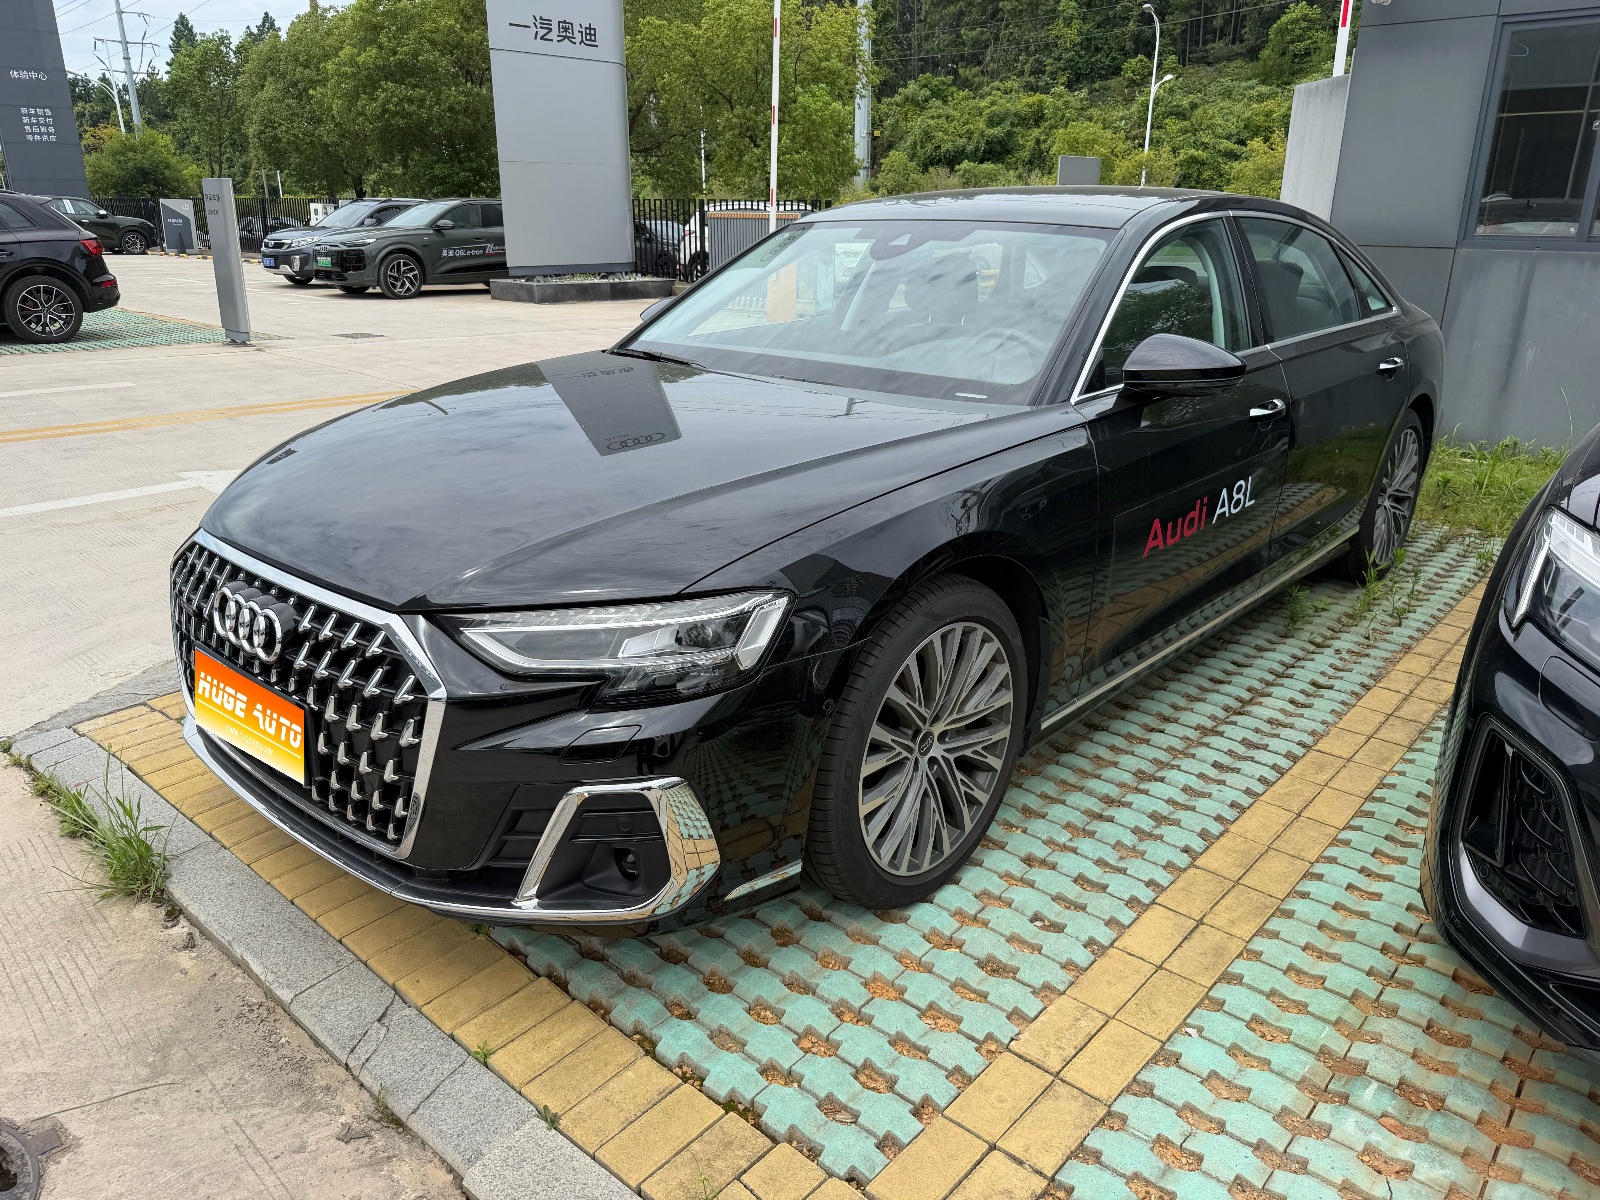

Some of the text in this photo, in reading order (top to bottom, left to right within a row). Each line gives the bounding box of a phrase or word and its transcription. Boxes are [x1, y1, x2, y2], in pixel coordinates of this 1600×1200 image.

[508, 15, 599, 48] 一汽奥迪
[9, 69, 48, 81] 体验中心
[20, 107, 52, 116] 新车销售
[22, 116, 53, 125] 新车交付
[24, 125, 55, 134] 售后服务
[1142, 475, 1255, 559] Audi A8L
